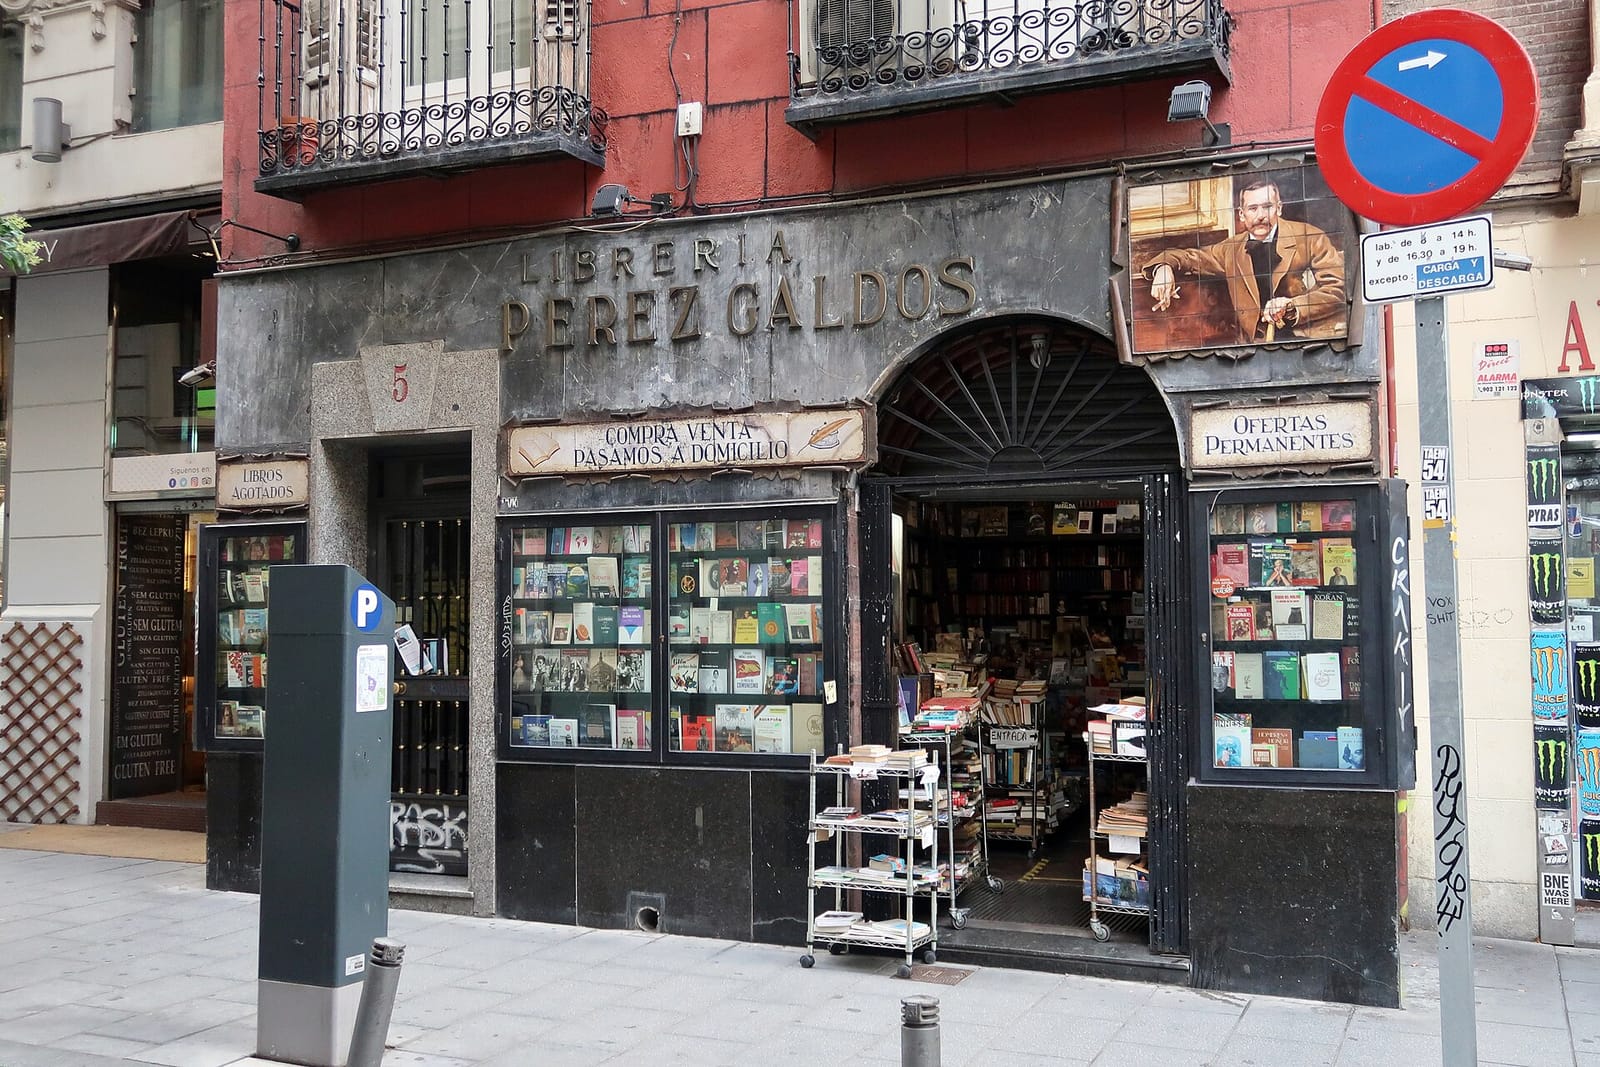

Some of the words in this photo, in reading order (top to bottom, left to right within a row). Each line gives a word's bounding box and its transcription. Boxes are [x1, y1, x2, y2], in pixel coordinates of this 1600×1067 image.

[1375, 242, 1393, 252] lab.
[1400, 238, 1412, 247] de
[1436, 234, 1442, 242] a
[1452, 229, 1464, 239] 14
[1467, 229, 1477, 238] h.
[1376, 258, 1381, 267] y
[1388, 254, 1399, 264] de
[1407, 250, 1433, 261] 16.30
[1440, 248, 1445, 256] a
[1453, 244, 1465, 254] 19
[1468, 243, 1477, 252] h.
[1422, 261, 1460, 275] CARGA
[1471, 259, 1479, 268] Y
[1418, 273, 1484, 289] DESCARGA
[501, 284, 702, 352] PEREZ
[727, 256, 977, 337] GALDOS
[392, 363, 408, 403] 5
[1476, 372, 1517, 382] ALARMA
[1233, 414, 1328, 435] OFERTAS
[605, 424, 680, 447] COMPRA
[687, 420, 752, 442] VENTA
[1205, 432, 1354, 456] PERMANENTES
[573, 446, 663, 468] PASAMOS
[672, 446, 685, 463] A
[691, 440, 789, 463] DOMICILIO
[243, 468, 283, 484] LIBROS
[1422, 460, 1446, 481] 54
[232, 485, 294, 501] AGOTADOS
[1425, 500, 1448, 520] 54
[1528, 508, 1559, 522] PYRAS
[149, 526, 174, 538] LEPKU
[131, 591, 148, 599] SEM
[1427, 595, 1453, 608] VOX
[357, 589, 378, 627] P
[133, 619, 149, 632] SEM
[151, 618, 182, 632] GLUTEM
[1427, 611, 1456, 625] SHIT
[139, 647, 151, 655] SIN
[152, 646, 179, 655] GLUTEN
[130, 733, 162, 748] GLUTEM
[114, 761, 151, 780] GLUTEN
[155, 759, 176, 776] FREE
[1543, 874, 1569, 889] BNE
[1544, 889, 1569, 898] WAS
[1544, 897, 1570, 906] HERE
